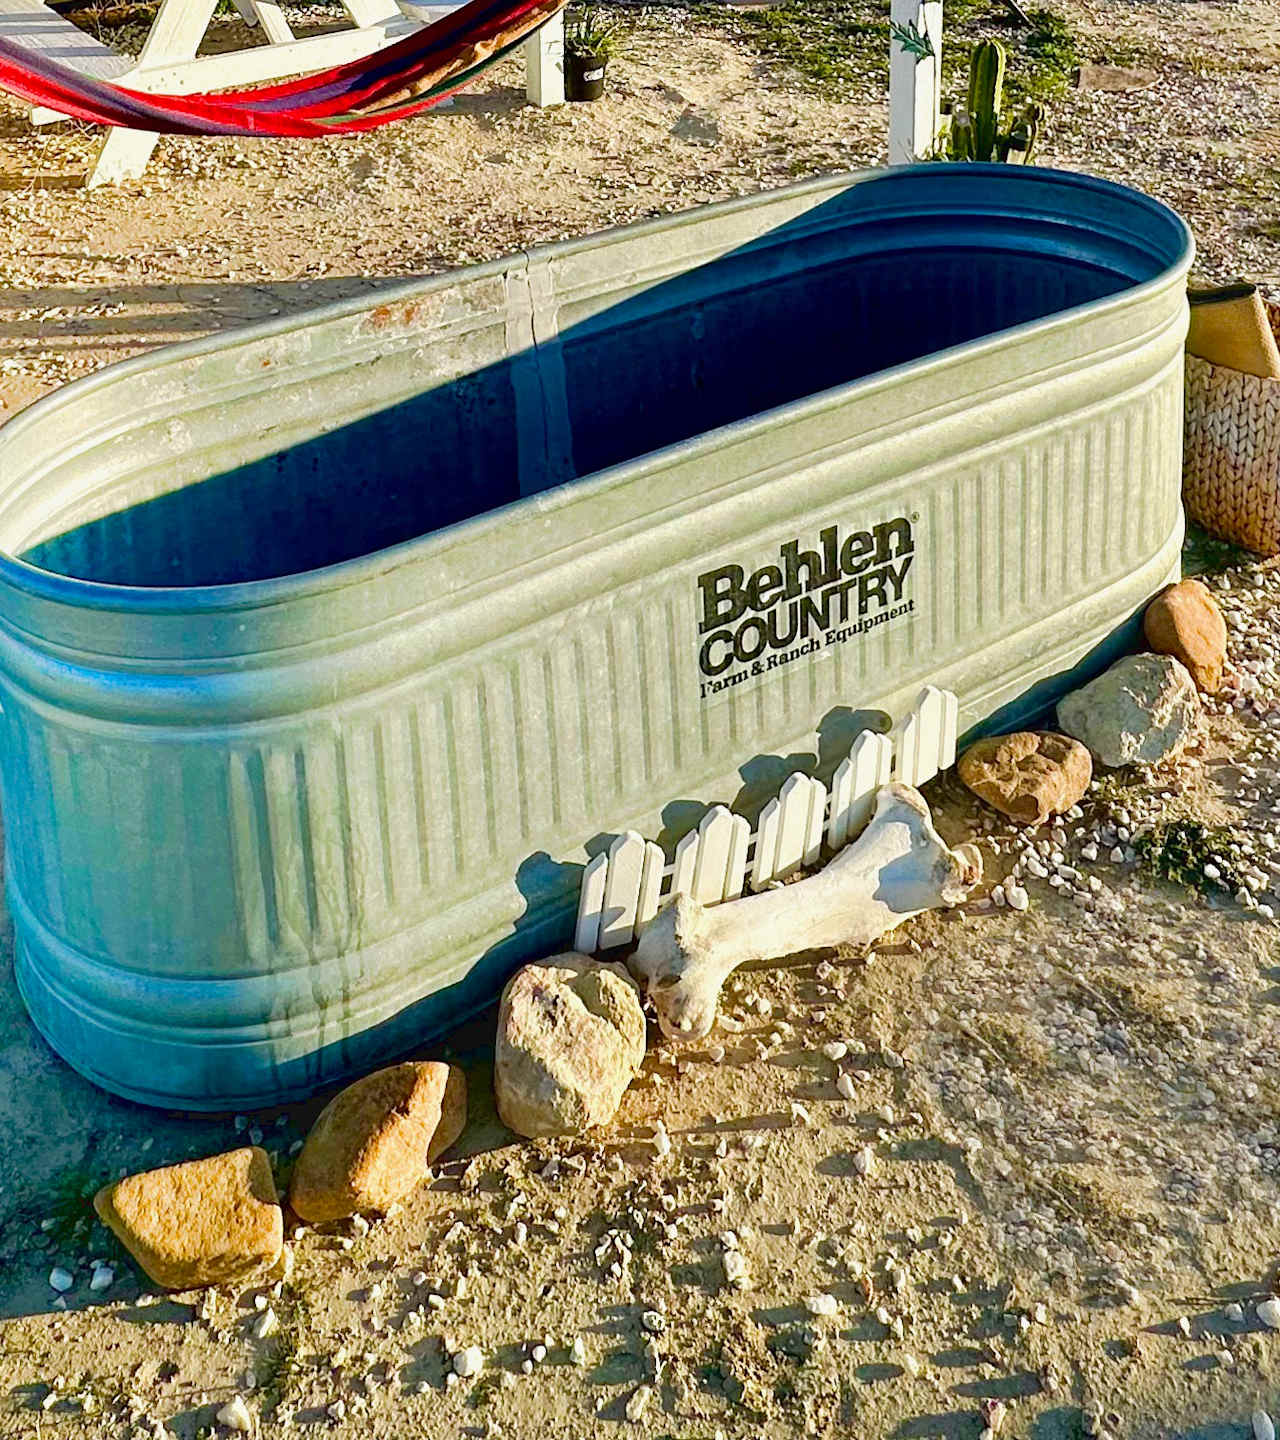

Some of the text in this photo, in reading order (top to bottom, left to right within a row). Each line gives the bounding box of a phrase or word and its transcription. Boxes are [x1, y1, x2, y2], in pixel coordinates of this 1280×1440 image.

[698, 517, 915, 635] Behlen
[699, 555, 915, 677] COUNTRY
[700, 598, 915, 699] Farm & Ranch Equipment
